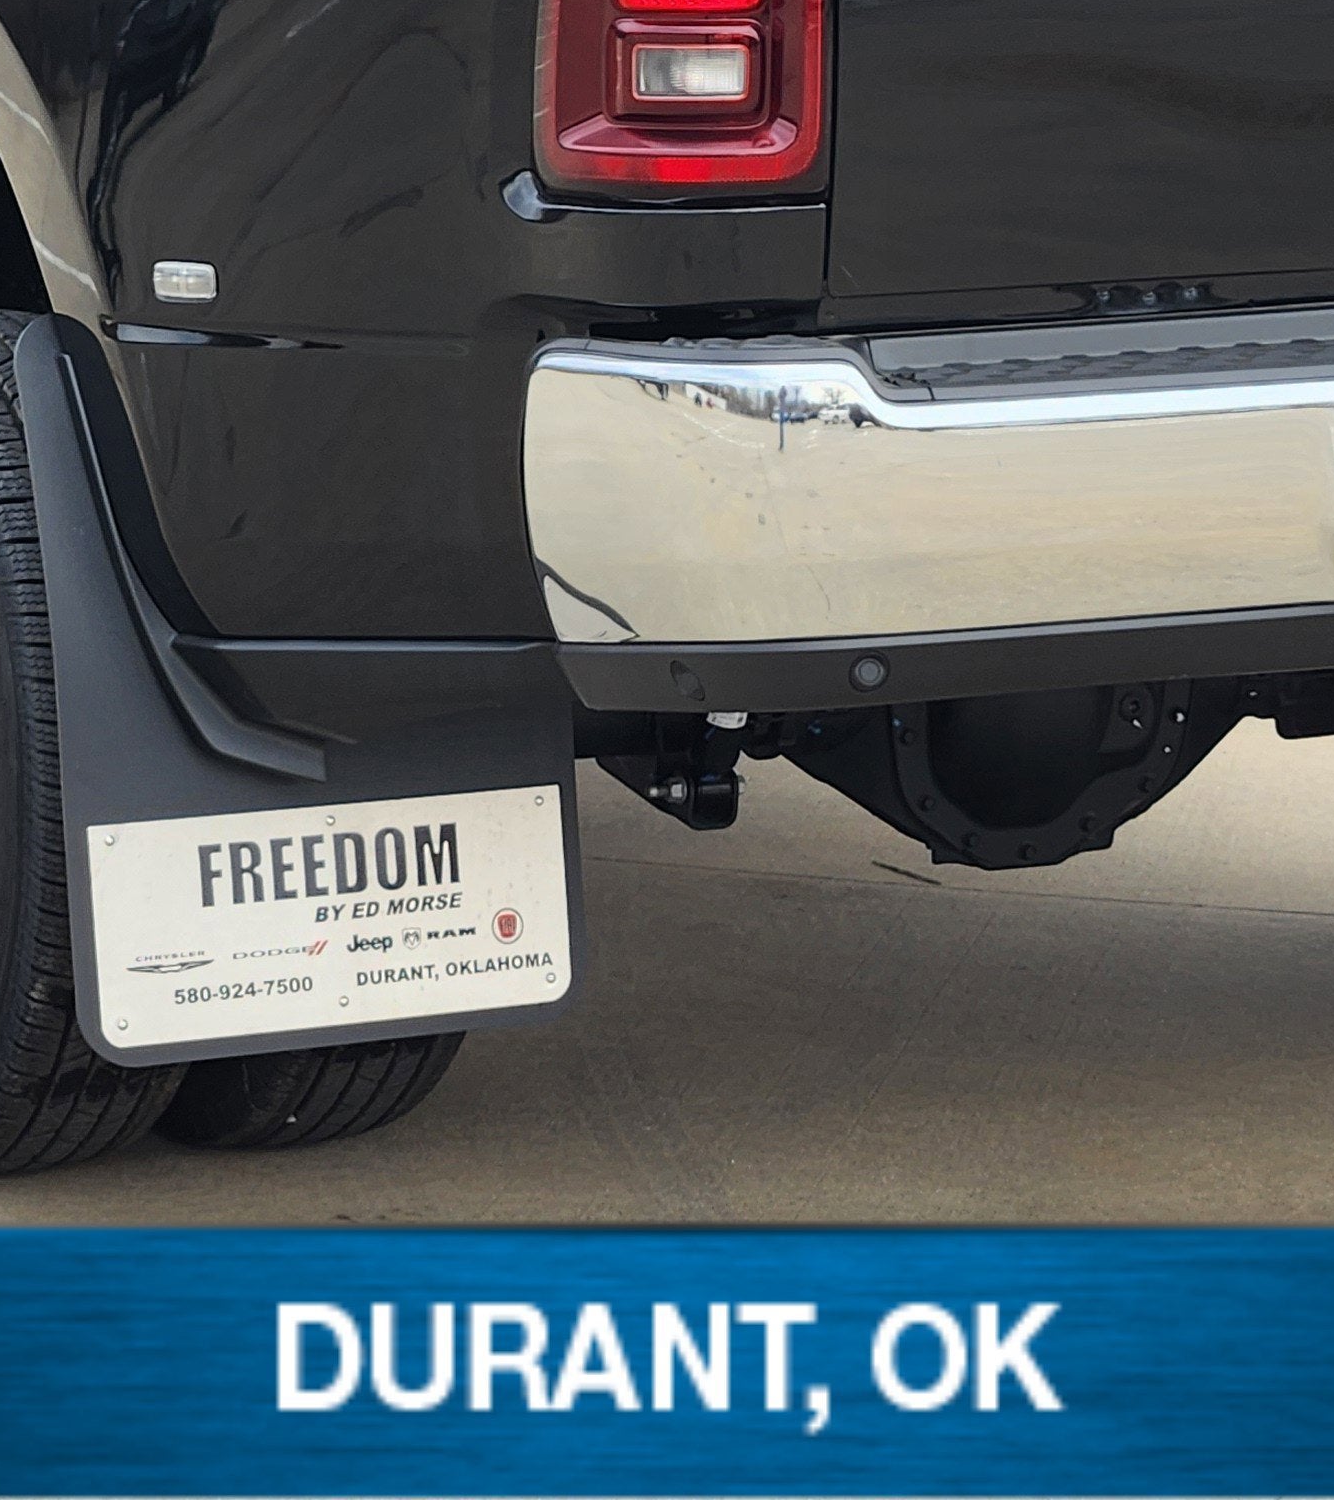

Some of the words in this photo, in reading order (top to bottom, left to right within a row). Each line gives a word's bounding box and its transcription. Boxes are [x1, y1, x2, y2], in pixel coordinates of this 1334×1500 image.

[197, 822, 462, 908] FREEDOM
[314, 904, 347, 924] BY
[351, 900, 381, 920] ED
[386, 892, 464, 917] MORSE
[231, 944, 315, 961] DODGE
[346, 933, 394, 955] Jeep
[426, 925, 477, 940] RAM
[355, 964, 440, 988] DURANT,
[444, 951, 554, 978] OKLAHOMA
[173, 975, 315, 1006] 580-924-7500
